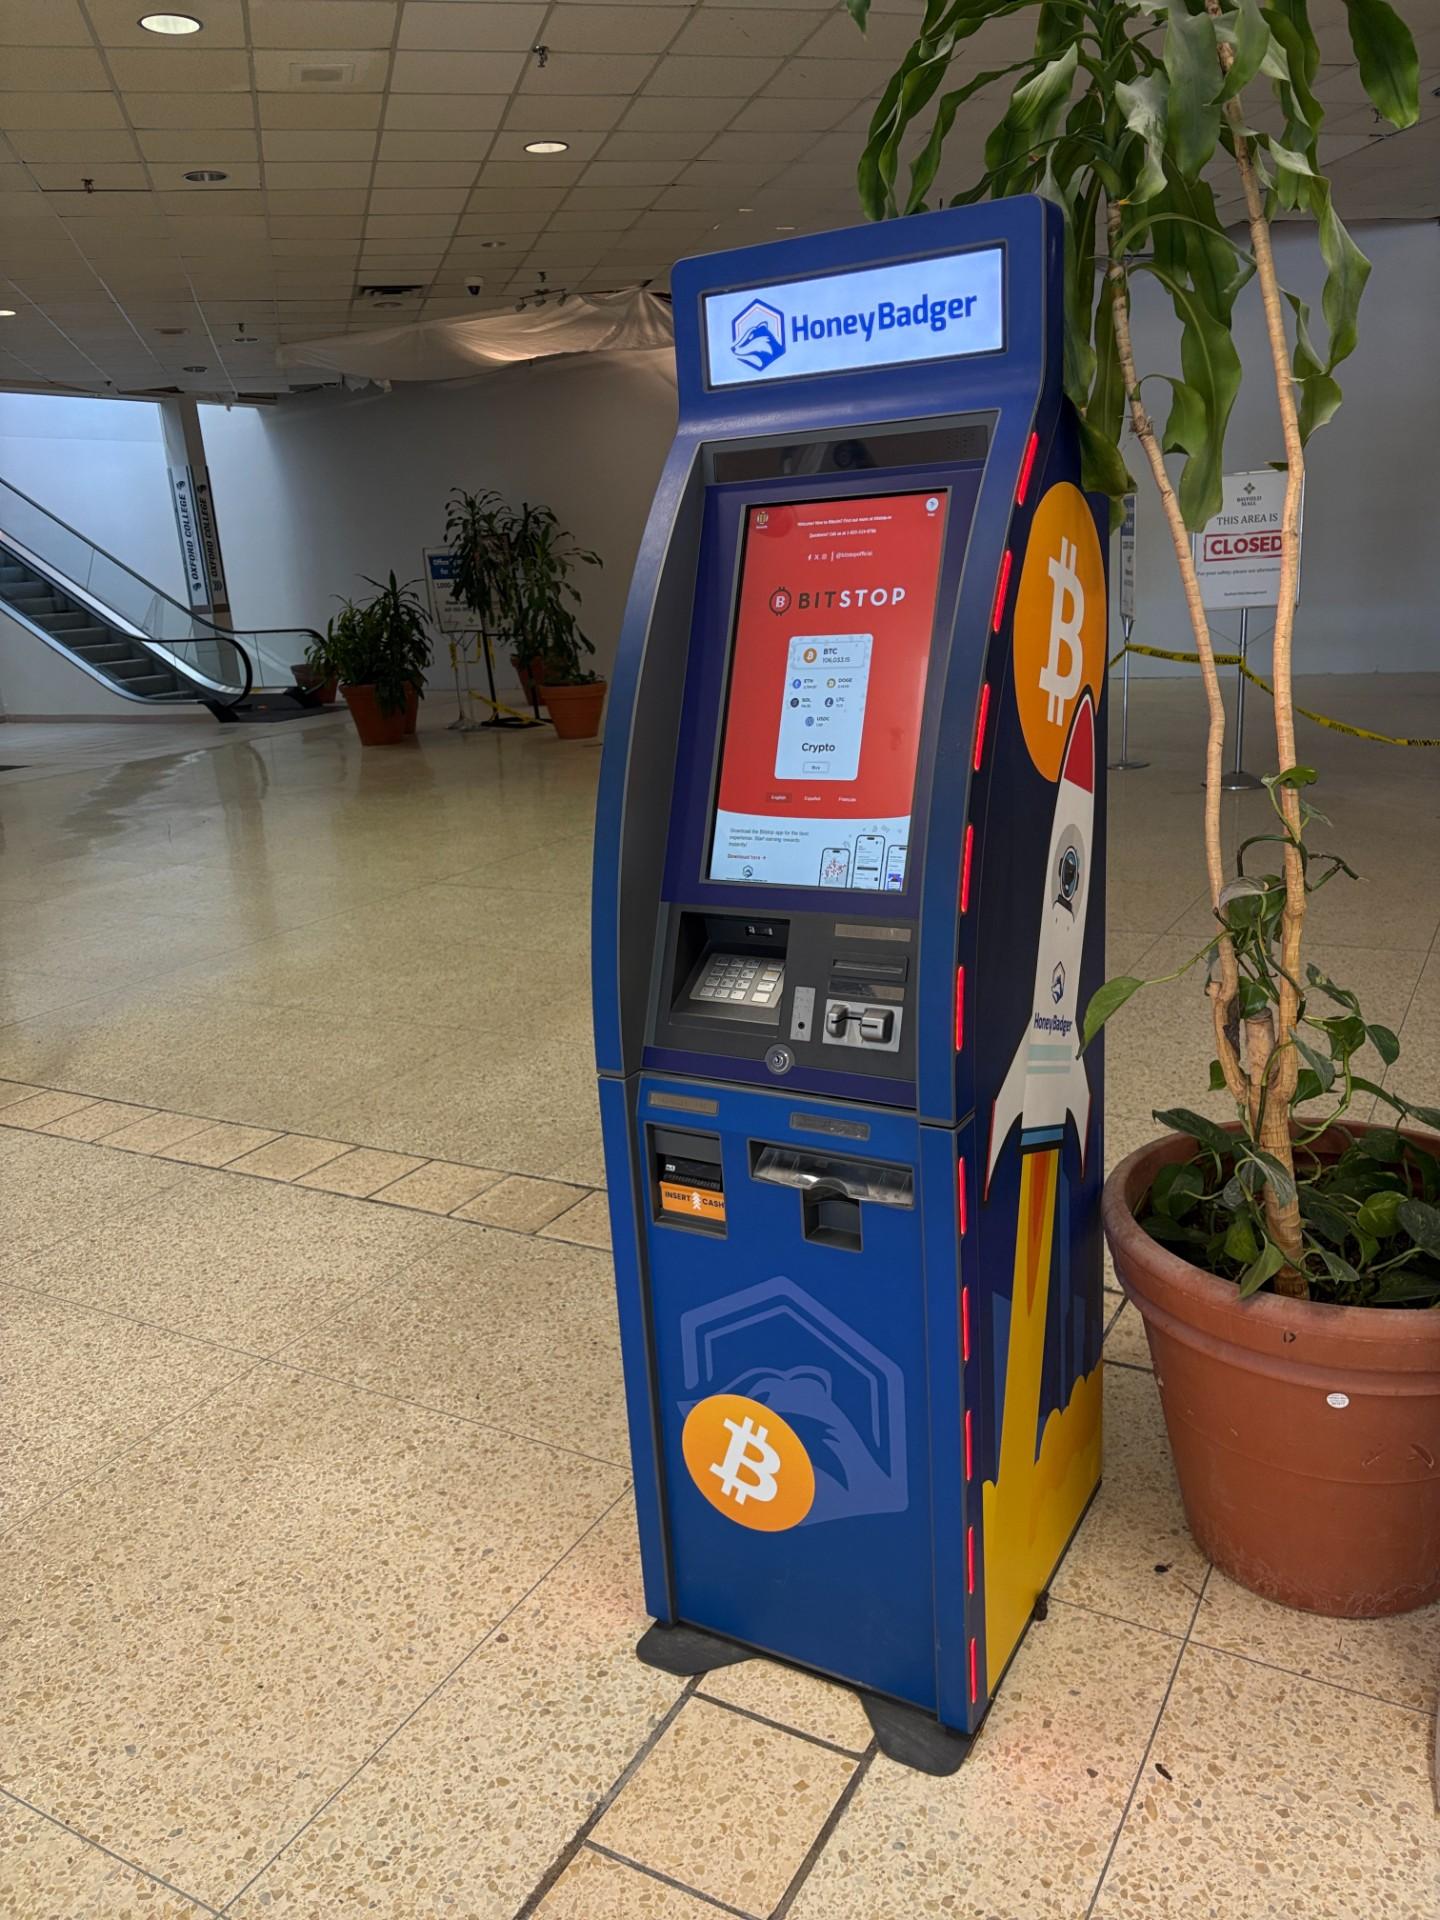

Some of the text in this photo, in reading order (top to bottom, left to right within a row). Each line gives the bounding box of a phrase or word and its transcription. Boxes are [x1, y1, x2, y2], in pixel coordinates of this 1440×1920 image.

[791, 294, 977, 342] HoneyBadger
[1217, 512, 1278, 526] THIS AREA IS
[179, 494, 199, 580] OXFORD COLLEGE
[199, 497, 218, 577] OXFORD COLLEGE
[1210, 536, 1282, 555] CLOSED
[798, 587, 906, 609] BITSTOP
[801, 742, 836, 754] Crypto
[1033, 1012, 1073, 1037] HoneyBadger
[665, 1191, 725, 1209] INSERT CASH
